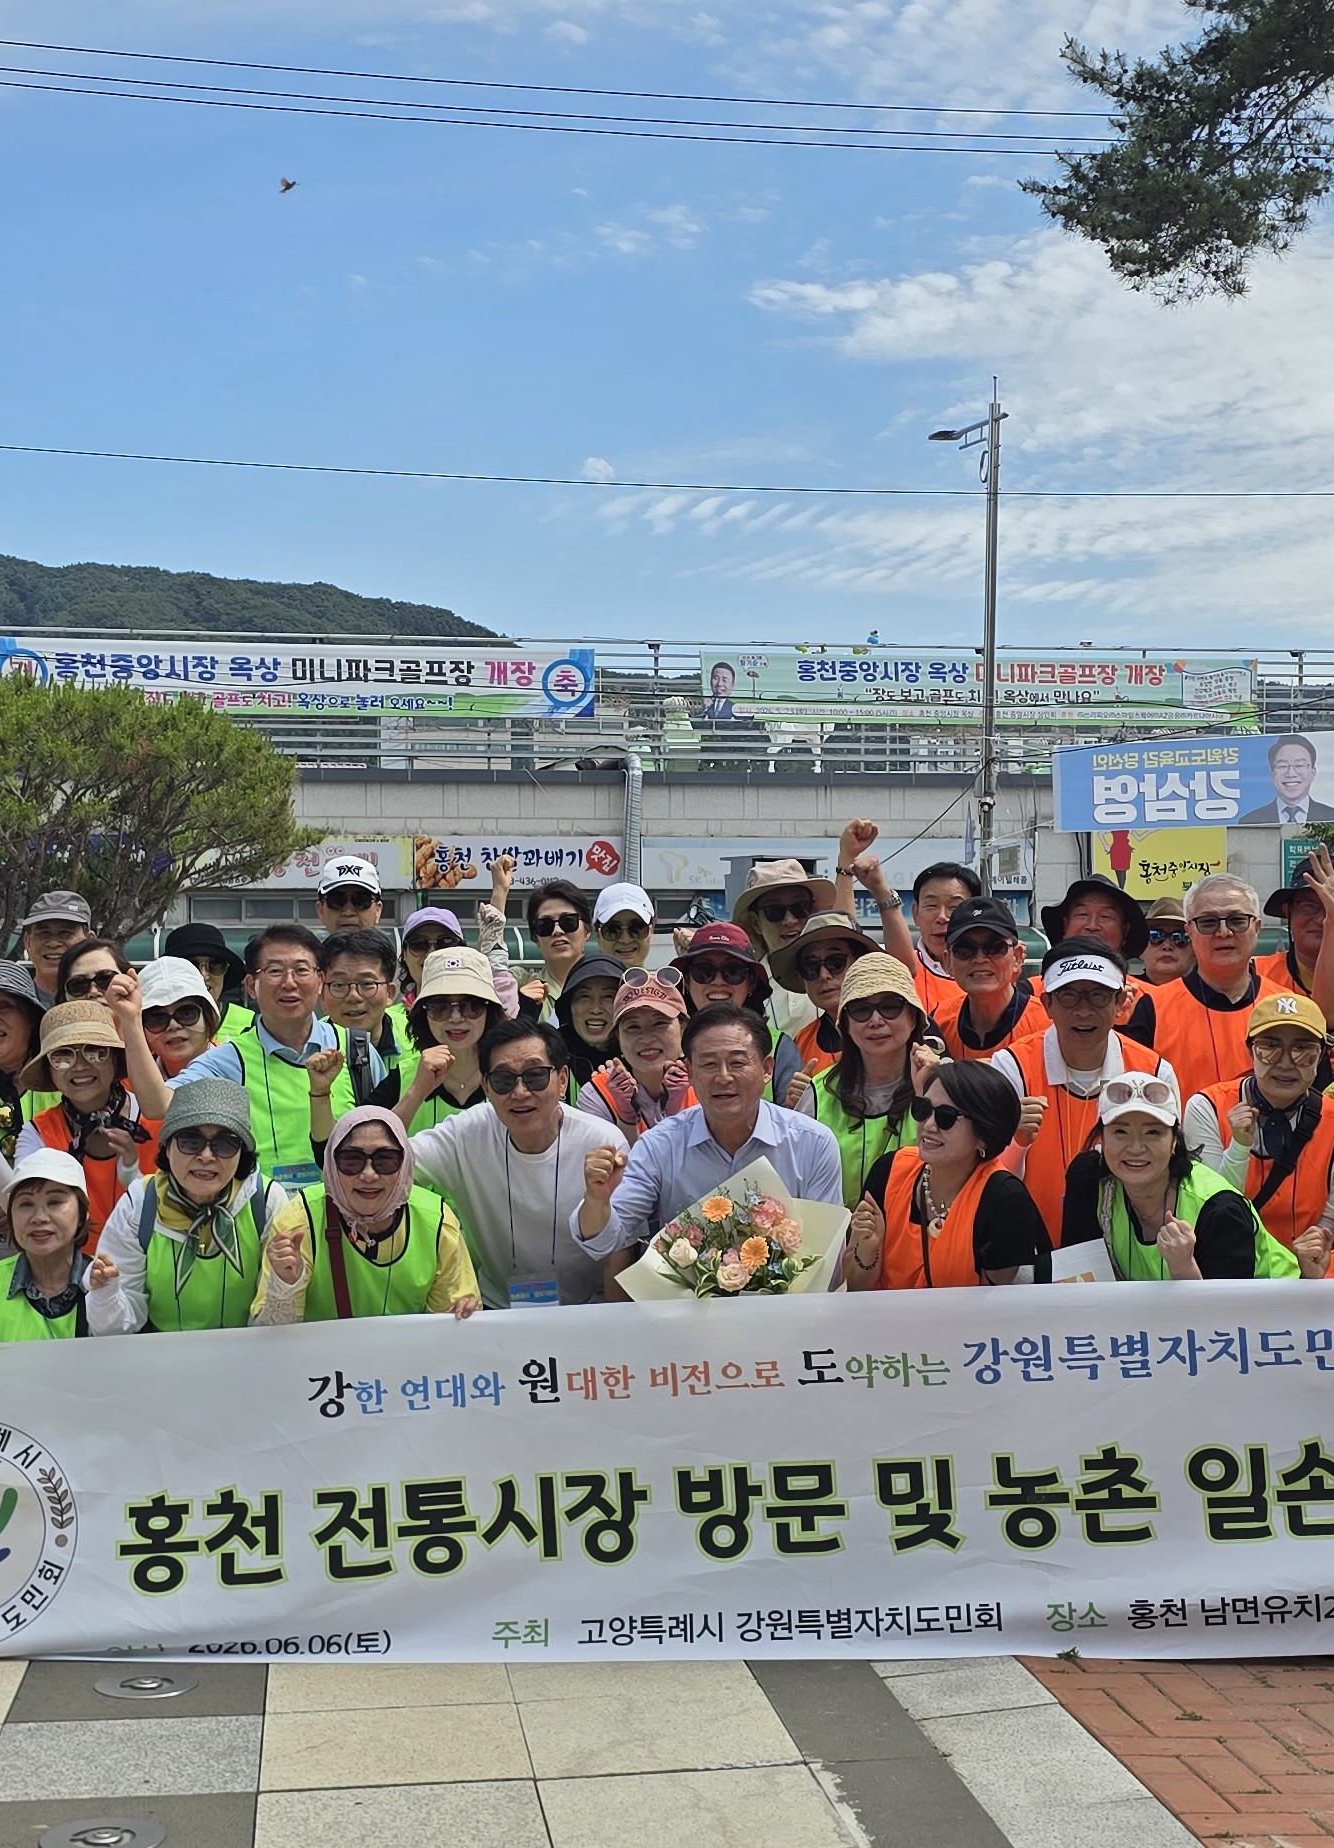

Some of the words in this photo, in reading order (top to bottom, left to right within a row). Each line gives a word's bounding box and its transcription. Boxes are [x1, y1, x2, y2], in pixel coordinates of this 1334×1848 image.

[54, 651, 219, 682] 홍천중앙시장
[228, 656, 281, 682] 옥상
[291, 657, 475, 685] 미니파크골프장
[484, 660, 537, 686] 개장
[797, 660, 921, 683] 홍천중앙시장
[928, 661, 969, 684] 옥상
[1124, 664, 1166, 686] 개장
[553, 670, 581, 696] 축
[212, 691, 254, 708] 골프도
[257, 691, 292, 708] 치고!
[297, 693, 351, 710] 옥상으로
[434, 845, 473, 874] 홍천
[591, 845, 619, 873] 맛집
[1138, 858, 1220, 885] 홍천중앙시장
[689, 875, 702, 885] SK
[1057, 958, 1105, 978] Titleist
[1276, 997, 1299, 1015] NY
[307, 1369, 386, 1420] 강한
[399, 1370, 507, 1412] 연대와
[517, 1356, 634, 1405] 원대한
[646, 1359, 786, 1398] 비전으로
[796, 1346, 952, 1391] 도약하는
[116, 1484, 289, 1599] 홍천
[309, 1463, 652, 1580] 전통시장
[673, 1455, 850, 1564] 방문
[871, 1450, 968, 1556] 및
[984, 1440, 1161, 1551] 농촌
[490, 1615, 552, 1650] 주최
[577, 1610, 727, 1648] 고양특례시
[734, 1602, 1005, 1644] 강원특별자치도민회
[1046, 1600, 1110, 1634] 장소
[1126, 1597, 1190, 1632] 홍천
